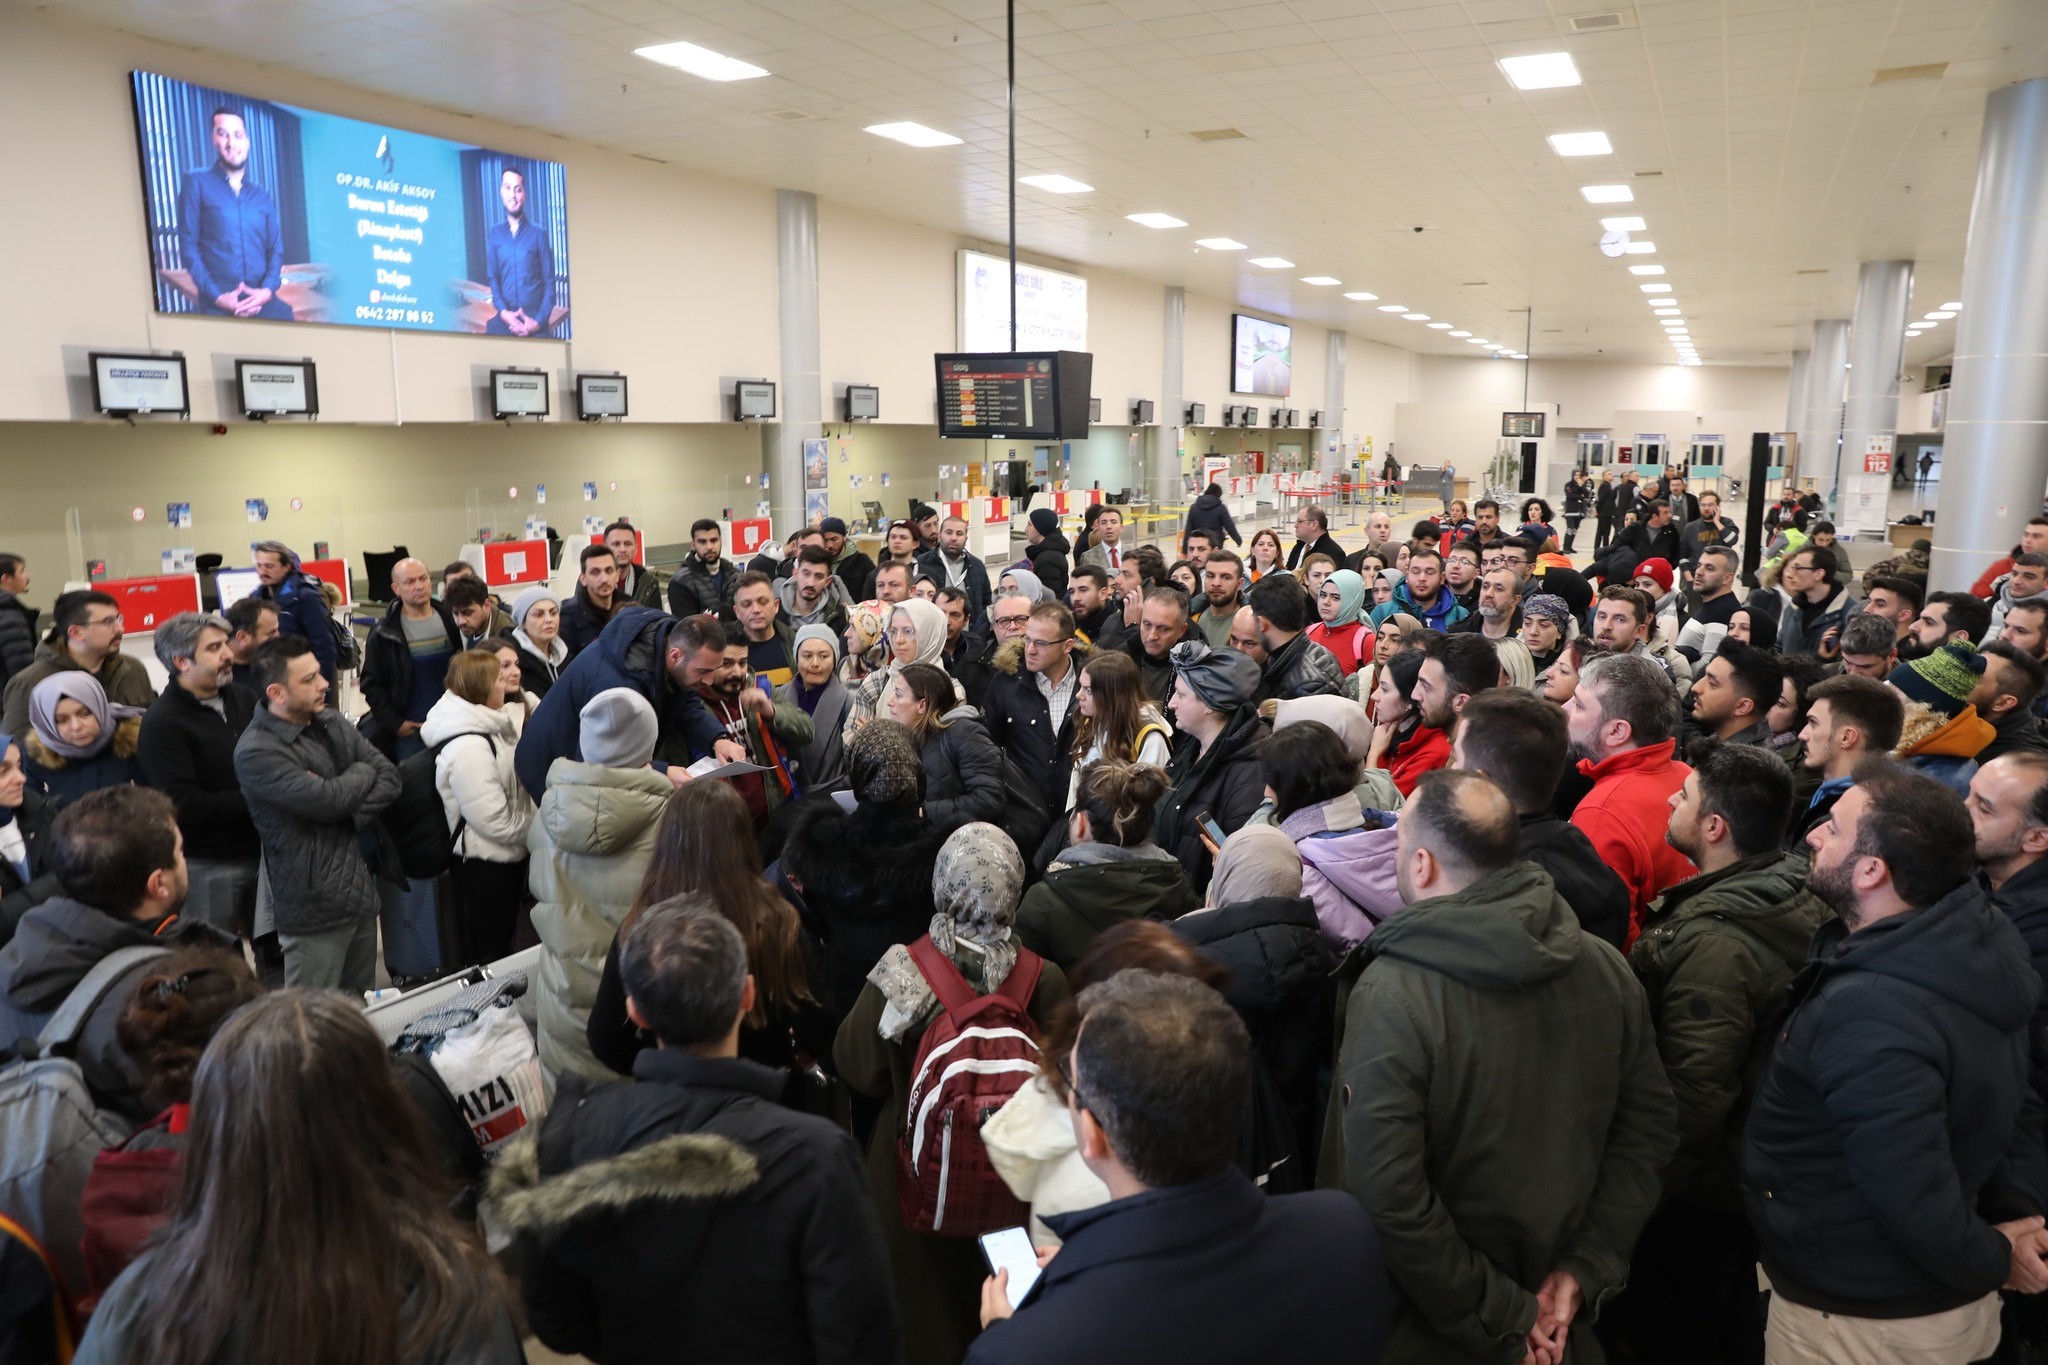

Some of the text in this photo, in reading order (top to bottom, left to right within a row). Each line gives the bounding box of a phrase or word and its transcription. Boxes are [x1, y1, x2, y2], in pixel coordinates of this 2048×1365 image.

[401, 183, 437, 200] AKSOY
[355, 305, 384, 319] 0542
[1867, 461, 1888, 472] 112
